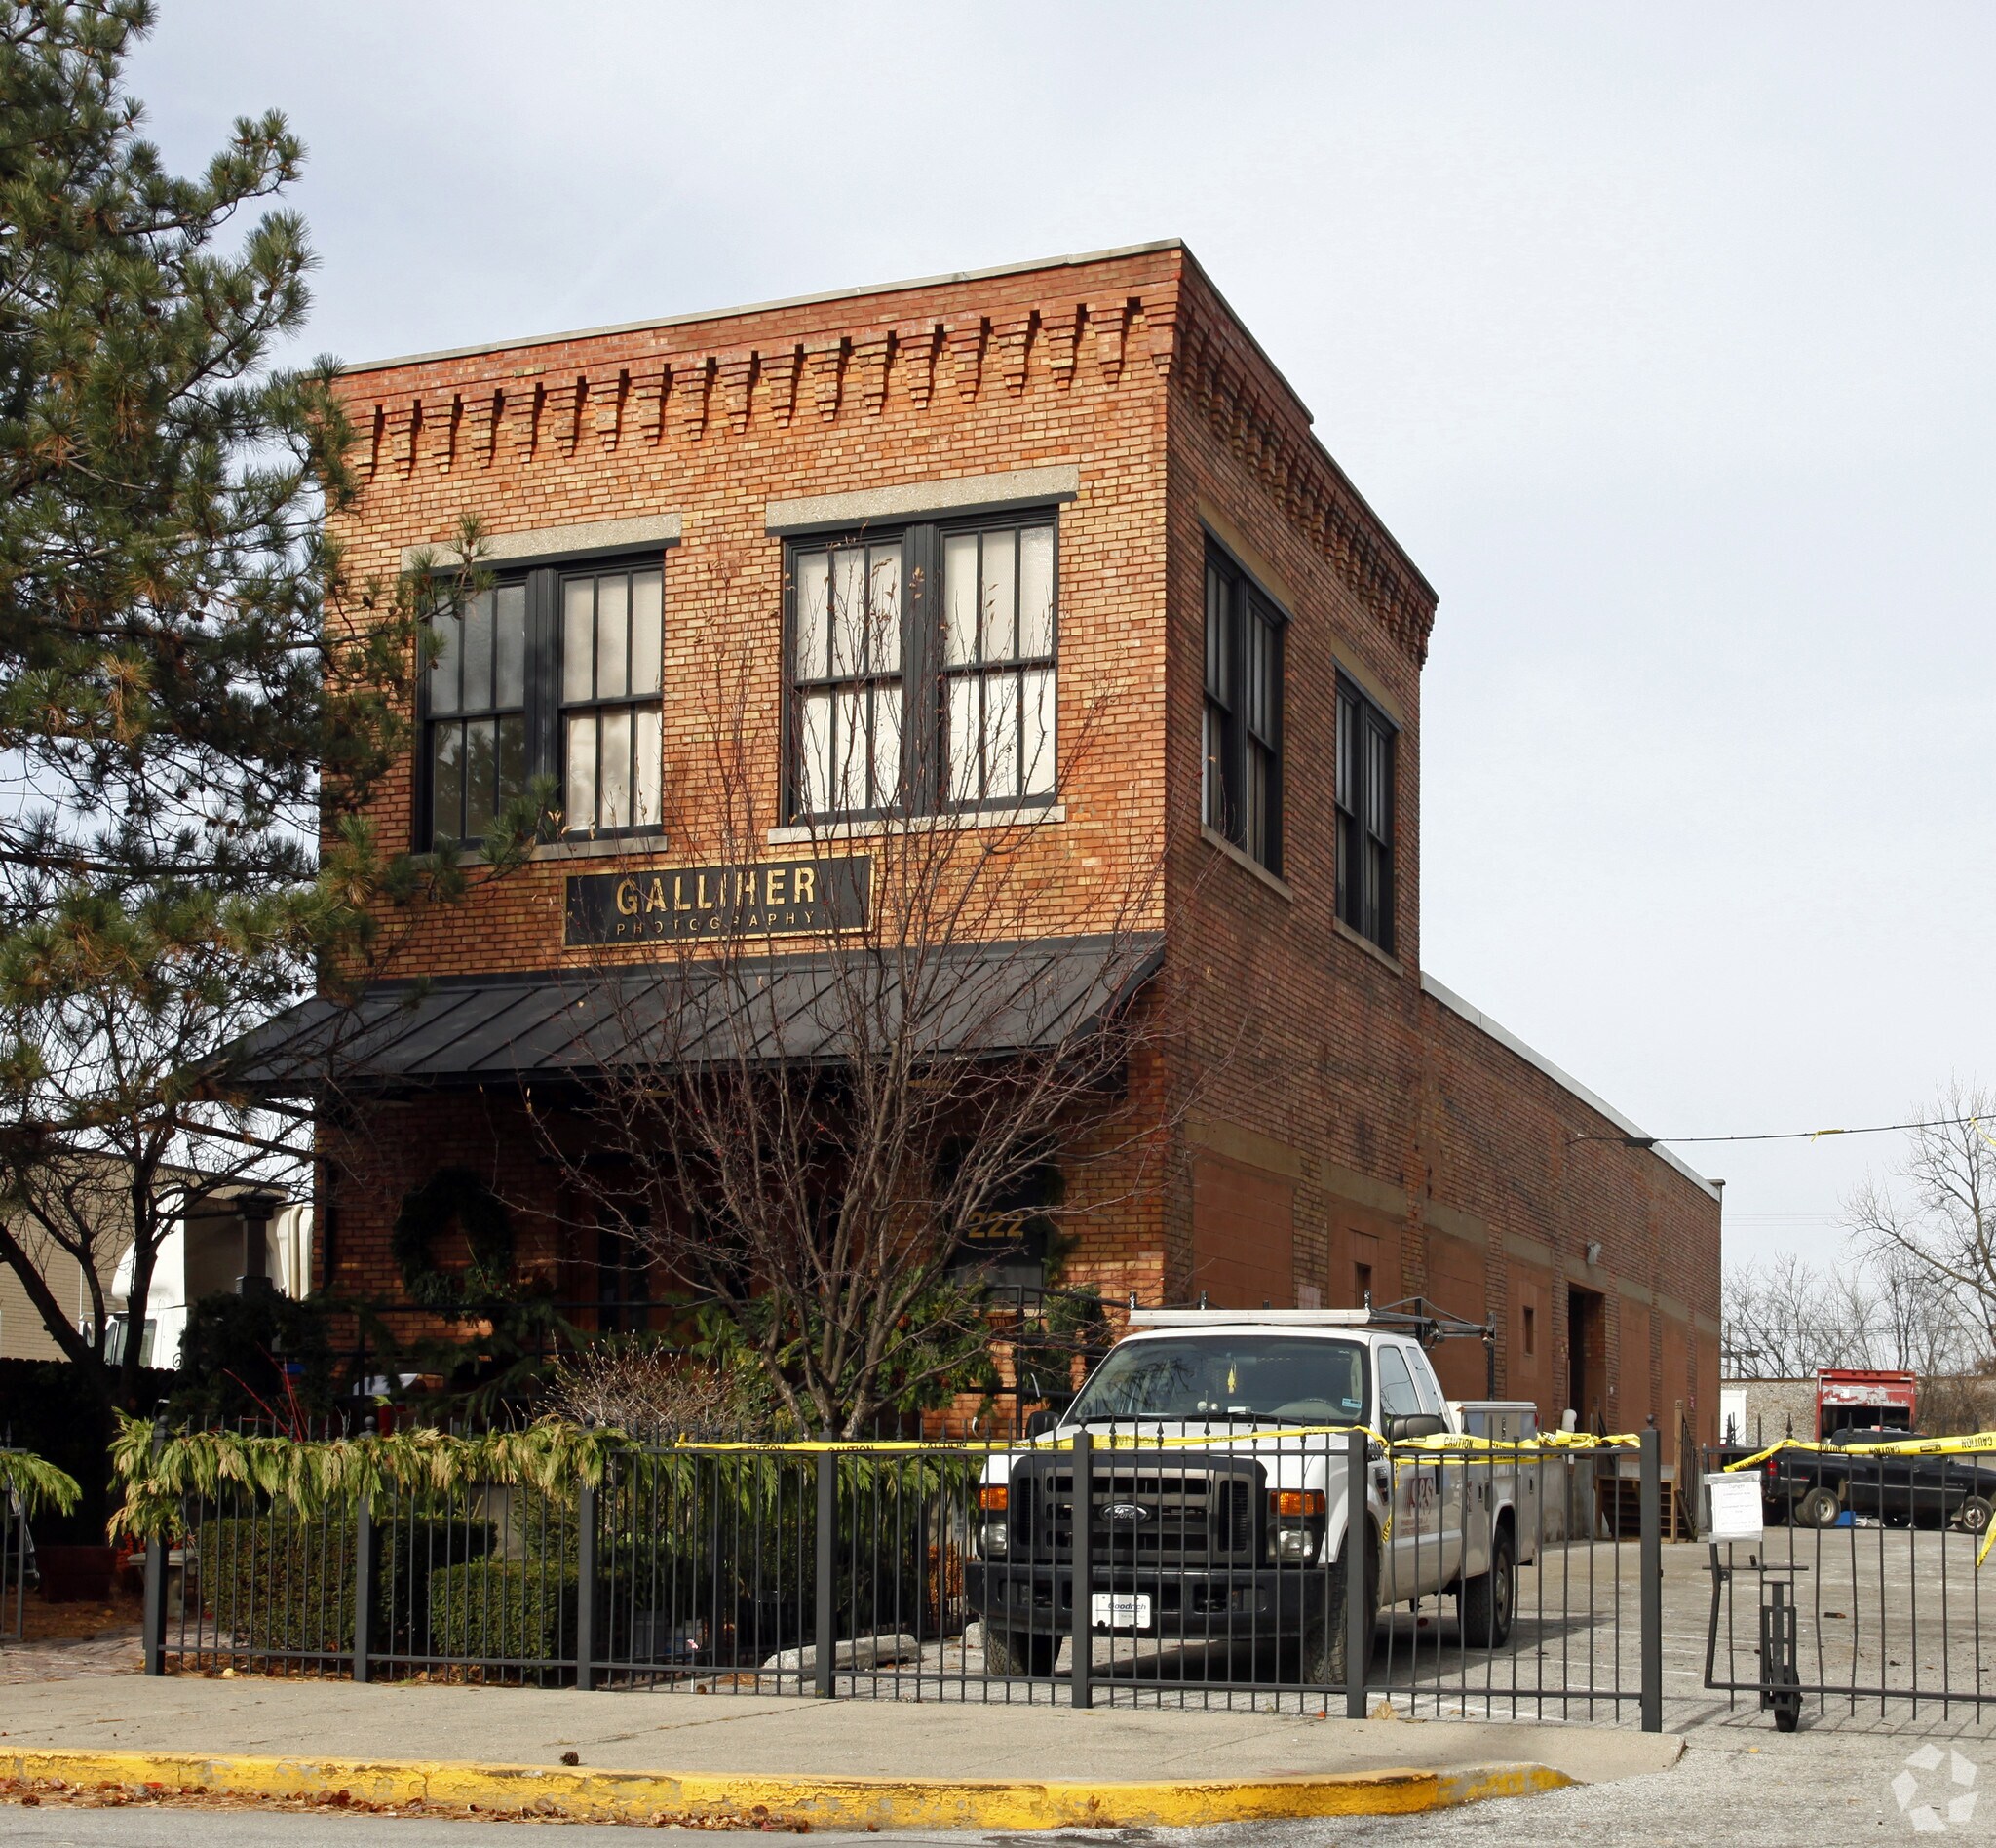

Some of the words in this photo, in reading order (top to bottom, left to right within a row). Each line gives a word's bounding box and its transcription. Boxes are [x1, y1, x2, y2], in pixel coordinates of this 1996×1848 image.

[616, 866, 815, 915] GALLIHER
[968, 1211, 1023, 1238] 222
[1443, 1436, 1474, 1448] CAUTION
[1961, 1436, 1993, 1448] CAUTION
[1114, 1507, 1135, 1519] Ford
